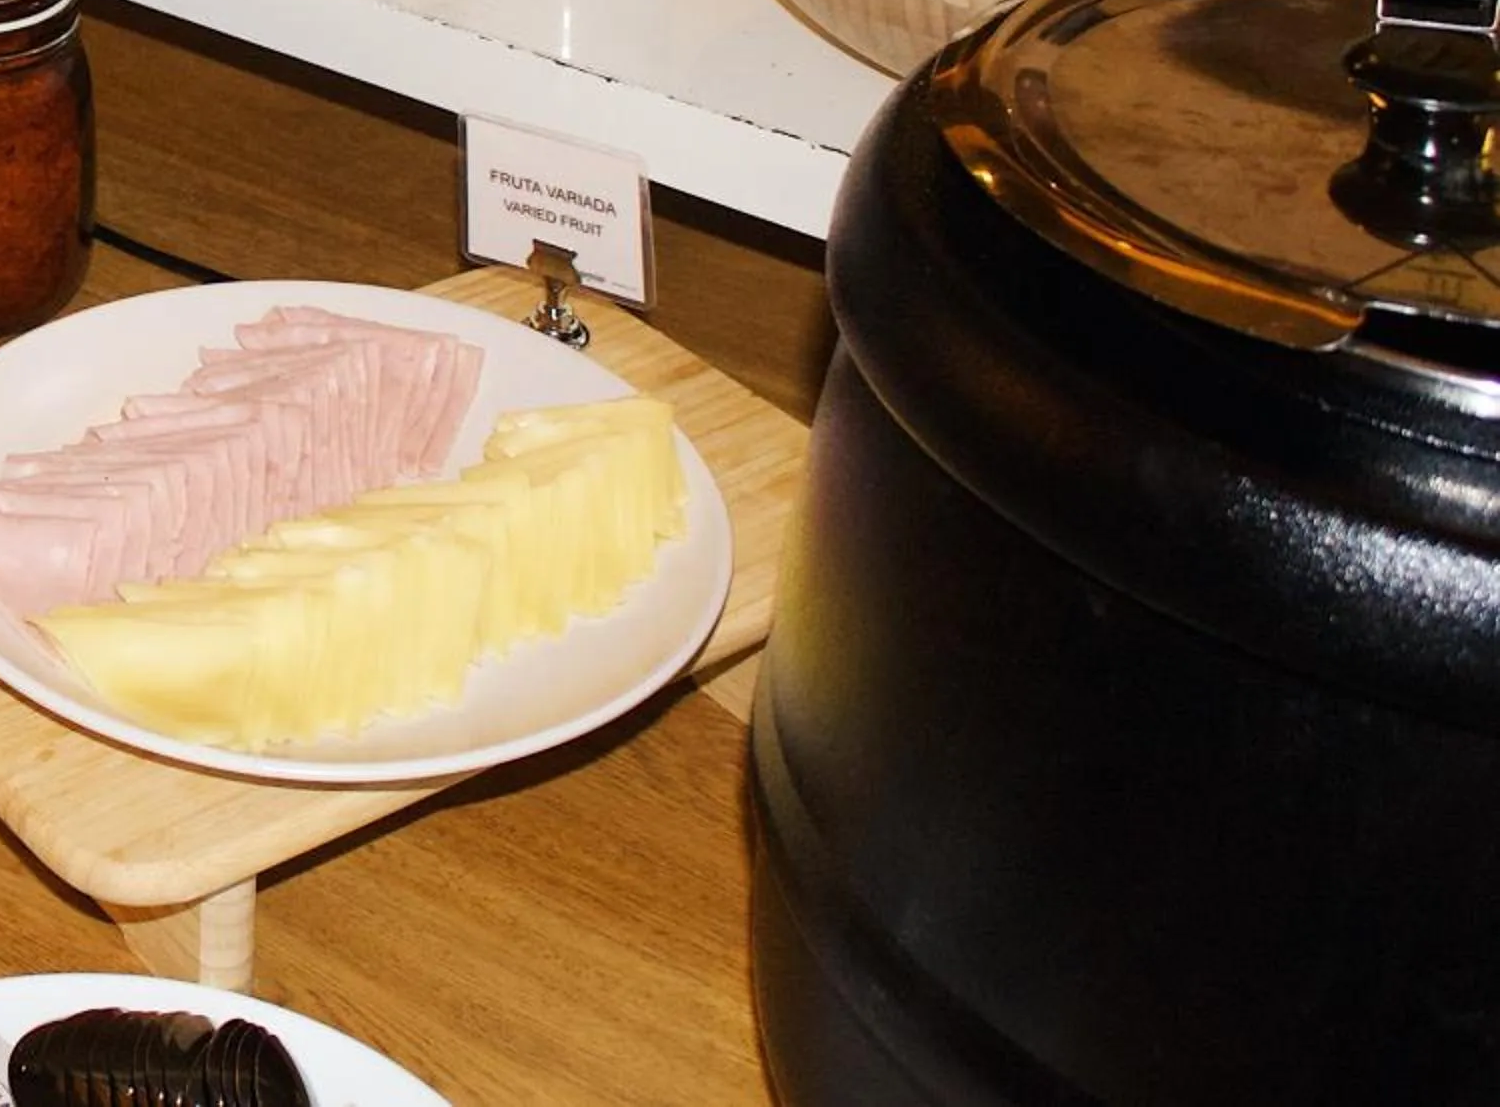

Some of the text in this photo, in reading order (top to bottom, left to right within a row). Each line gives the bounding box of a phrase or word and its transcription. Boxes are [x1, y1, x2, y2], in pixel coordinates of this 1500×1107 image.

[489, 168, 618, 218] FRUTA VARIADA
[503, 197, 604, 238] VARIED FRUIT
